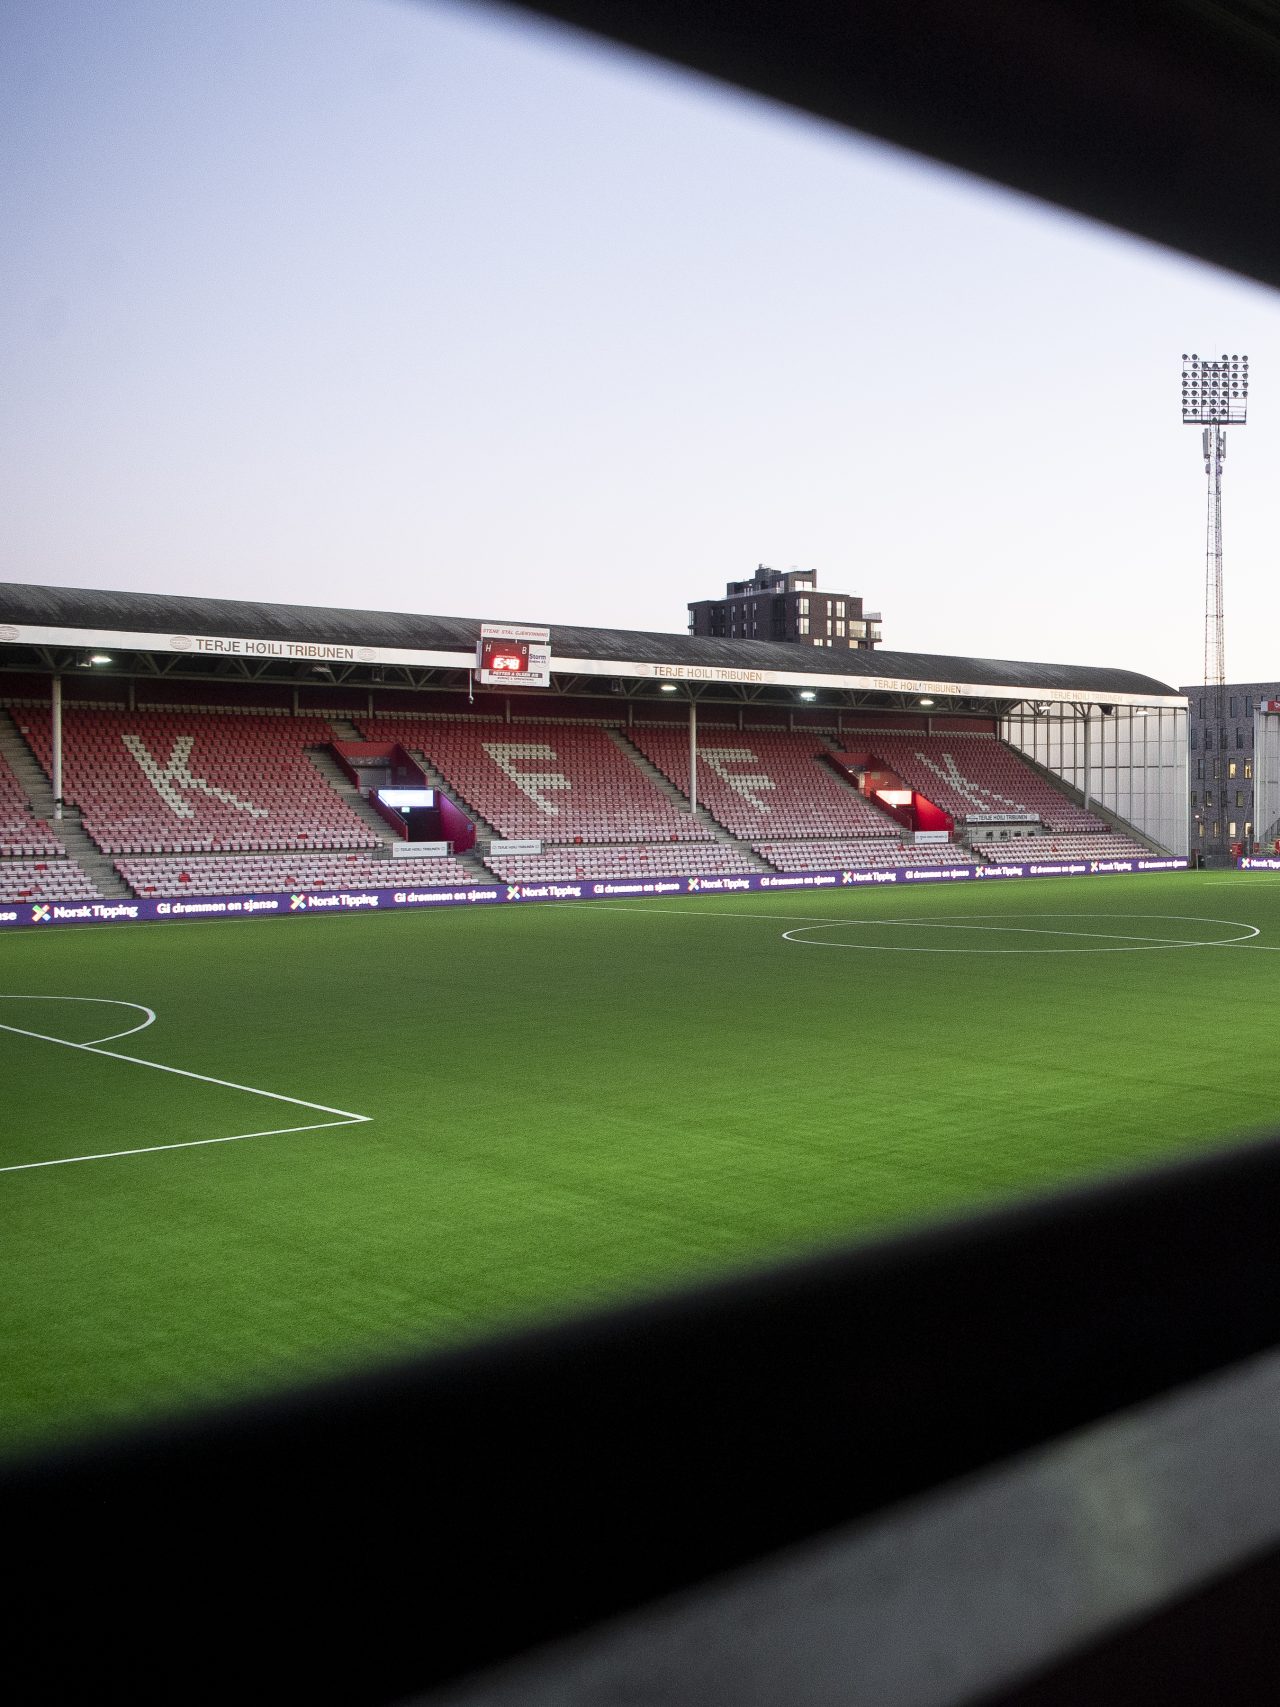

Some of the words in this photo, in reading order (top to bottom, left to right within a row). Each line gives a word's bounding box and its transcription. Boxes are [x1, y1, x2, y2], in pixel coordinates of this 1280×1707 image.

[196, 639, 240, 652] TERJE
[246, 642, 282, 655] HØILI
[287, 644, 353, 659] TRIBUNEN
[486, 644, 491, 652] H
[653, 666, 684, 677] TERJE
[687, 668, 712, 678] HØILI
[716, 669, 762, 681] TRIBUNEN
[873, 679, 898, 689] TERJE
[923, 683, 961, 694] TRIBUNEN
[701, 879, 723, 889] Norsk
[723, 878, 749, 889] Tipping
[853, 872, 873, 882] Norsk
[873, 872, 896, 882] Tipping
[394, 893, 406, 903] Gi
[454, 893, 466, 901] en
[466, 890, 497, 902] sjanse
[521, 887, 549, 897] Norsk
[549, 885, 581, 897] Tipping
[157, 902, 170, 914] Gi
[173, 901, 226, 913] drømmen
[228, 903, 241, 911] en
[243, 900, 278, 912] sjanse
[309, 895, 339, 907] Norsk
[340, 894, 378, 906] Tipping
[54, 906, 91, 919] Norsk
[92, 904, 138, 918] Tipping
